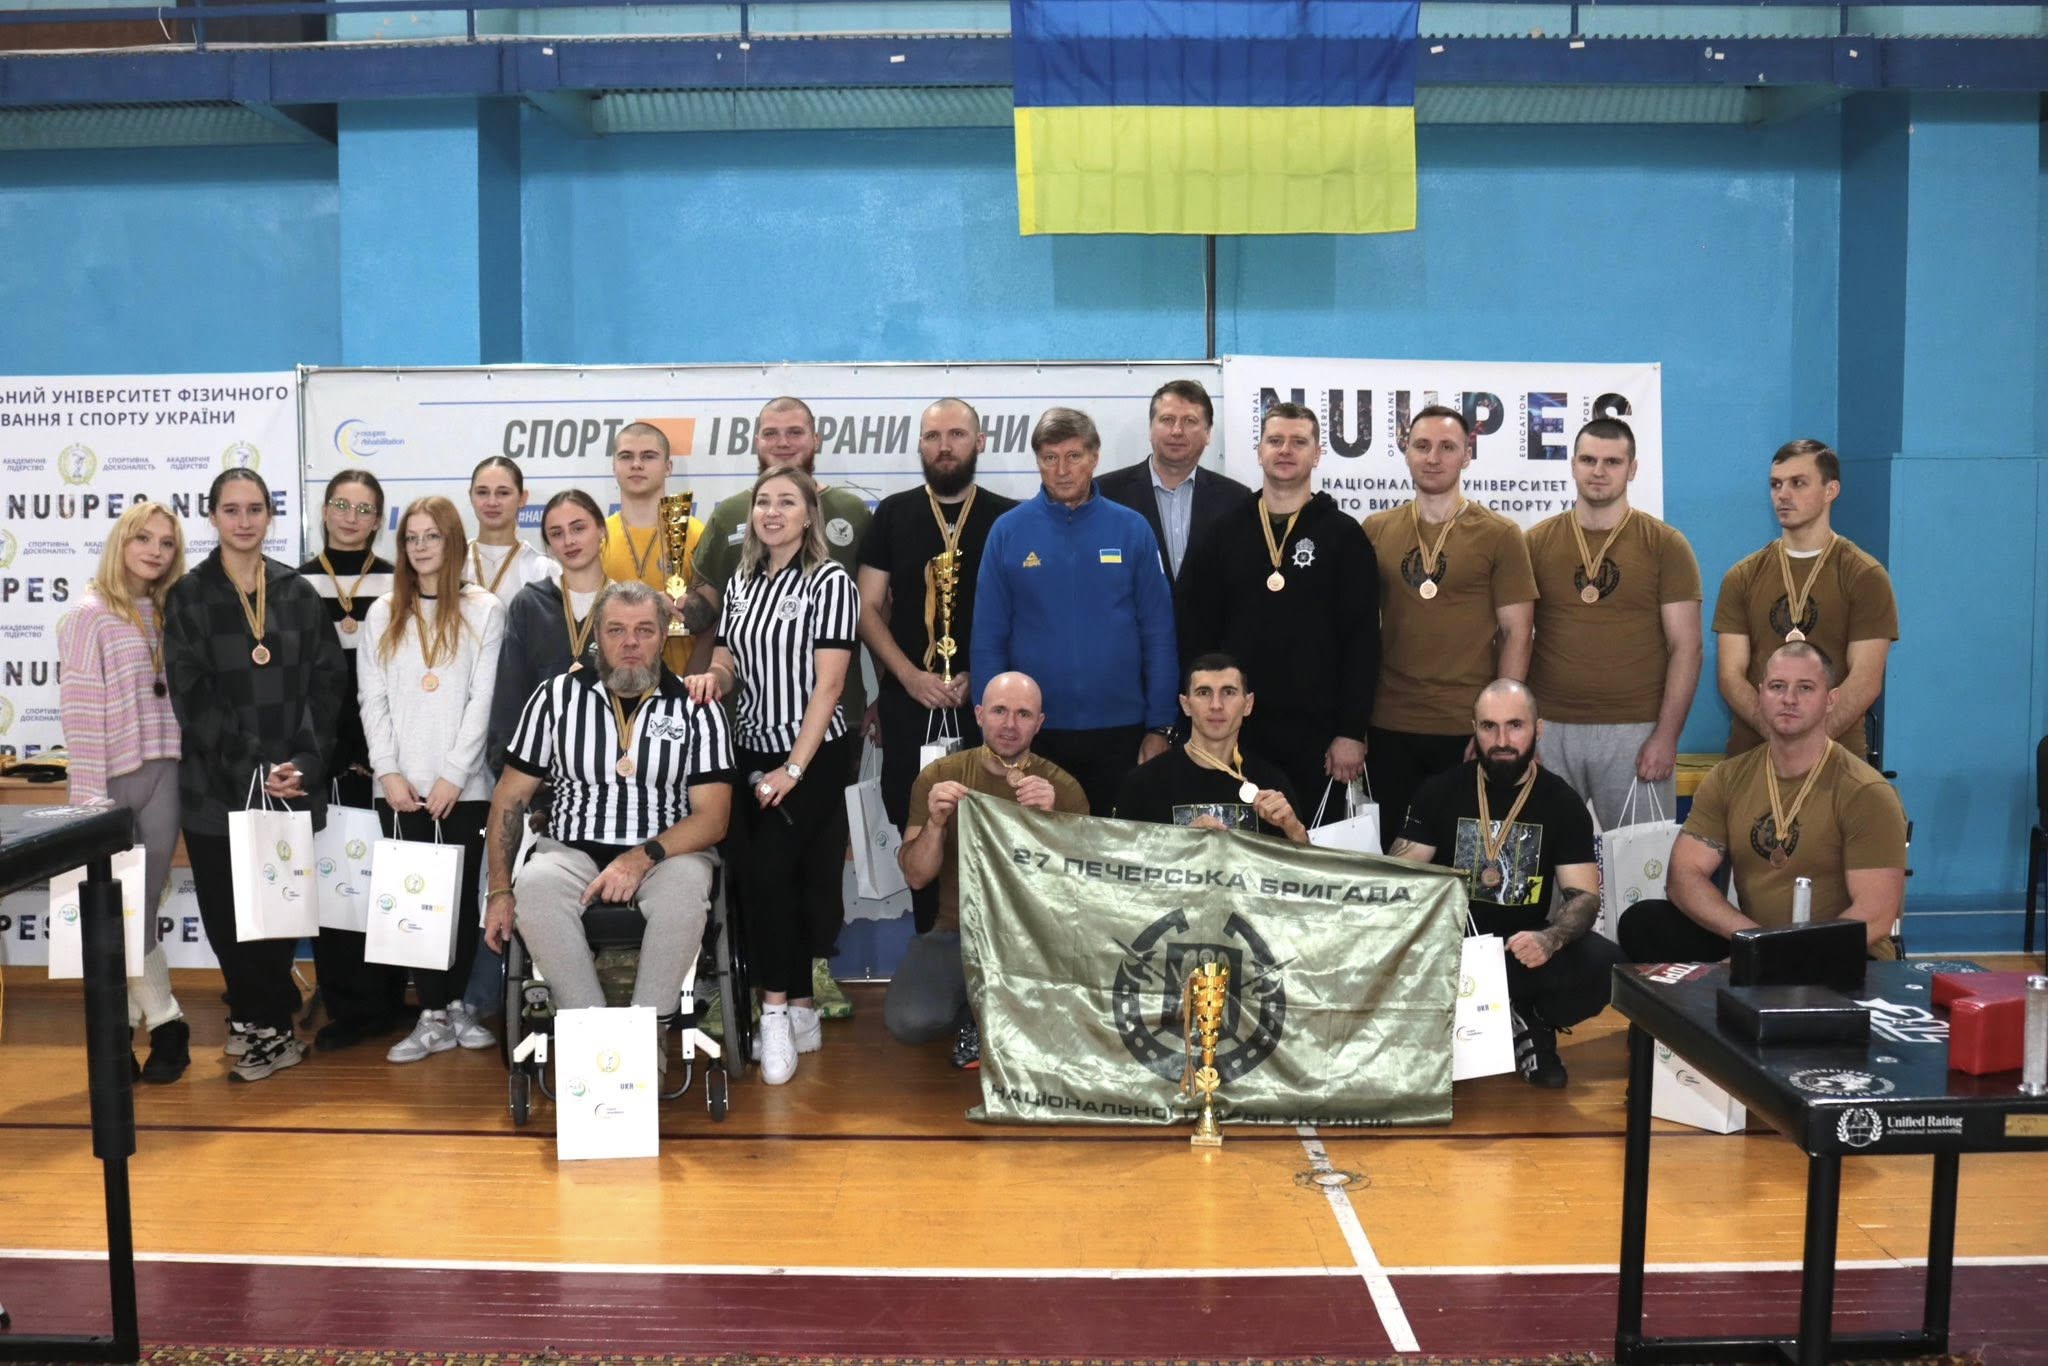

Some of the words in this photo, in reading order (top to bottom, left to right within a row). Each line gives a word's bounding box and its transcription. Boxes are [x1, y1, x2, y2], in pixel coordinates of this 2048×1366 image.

[0, 386, 45, 404] НИЙ
[52, 389, 171, 404] УНІВЕРСИТЕТ
[178, 386, 288, 402] ФІЗИЧНОГО
[67, 412, 73, 426] І
[80, 412, 149, 426] СПОРТУ
[155, 408, 235, 425] УКРАЇНИ
[1387, 391, 1395, 438] UKRAINE
[1582, 396, 1590, 423] PORT
[1320, 390, 1328, 456] UNIVERSITY
[503, 418, 624, 459] СПОРТ
[708, 417, 722, 456] І
[727, 415, 912, 455] ВРАНИ
[1322, 478, 1416, 491] НАЦІОНАЛ
[1463, 480, 1567, 492] УНІВЕРСИТЕТ
[1489, 500, 1551, 512] СПОРТУ
[1013, 848, 1051, 869] 27
[1064, 857, 1248, 891] ПЕЧЕРСЬКА
[1260, 878, 1411, 903] БРИГАДА
[1887, 1115, 1926, 1128] Unified
[1927, 1115, 1963, 1129] Rating
